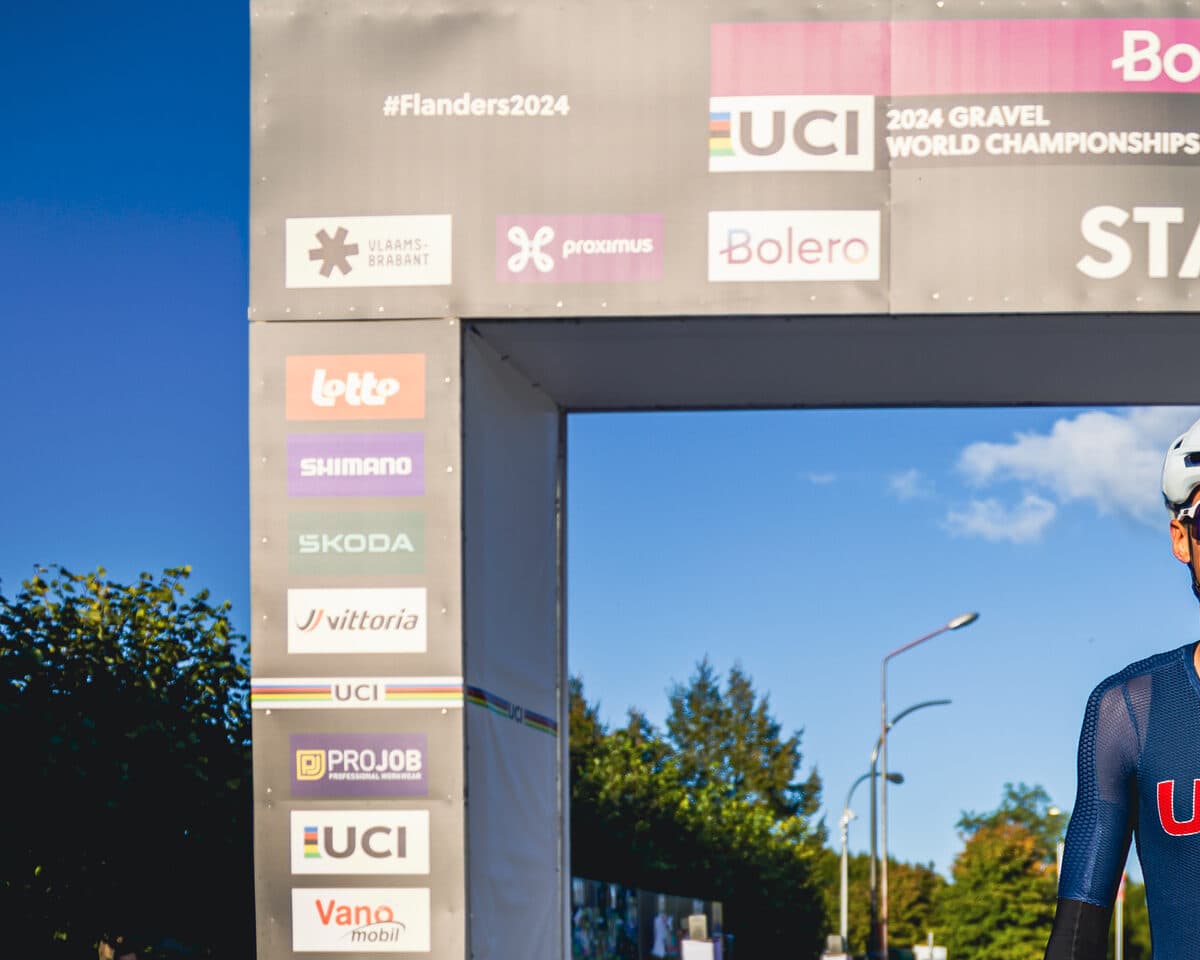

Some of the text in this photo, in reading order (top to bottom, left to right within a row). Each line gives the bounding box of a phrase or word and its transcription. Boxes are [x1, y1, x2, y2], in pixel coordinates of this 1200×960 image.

[383, 94, 570, 117] #Flanders2024
[886, 105, 1050, 131] 2024 GRAVEL
[738, 109, 859, 157] UCI
[886, 131, 1200, 158] WORLD CHAMPIONSHIPS
[562, 236, 654, 257] proximus
[719, 228, 869, 265] Bolero
[368, 252, 429, 267] BRABANT
[300, 456, 412, 477] SHIMANO
[327, 609, 419, 631] vittoria
[334, 684, 379, 702] UCI
[328, 749, 422, 771] PROJOB
[323, 826, 407, 858] UCI
[315, 899, 394, 926] Vano
[351, 927, 400, 943] mobil
